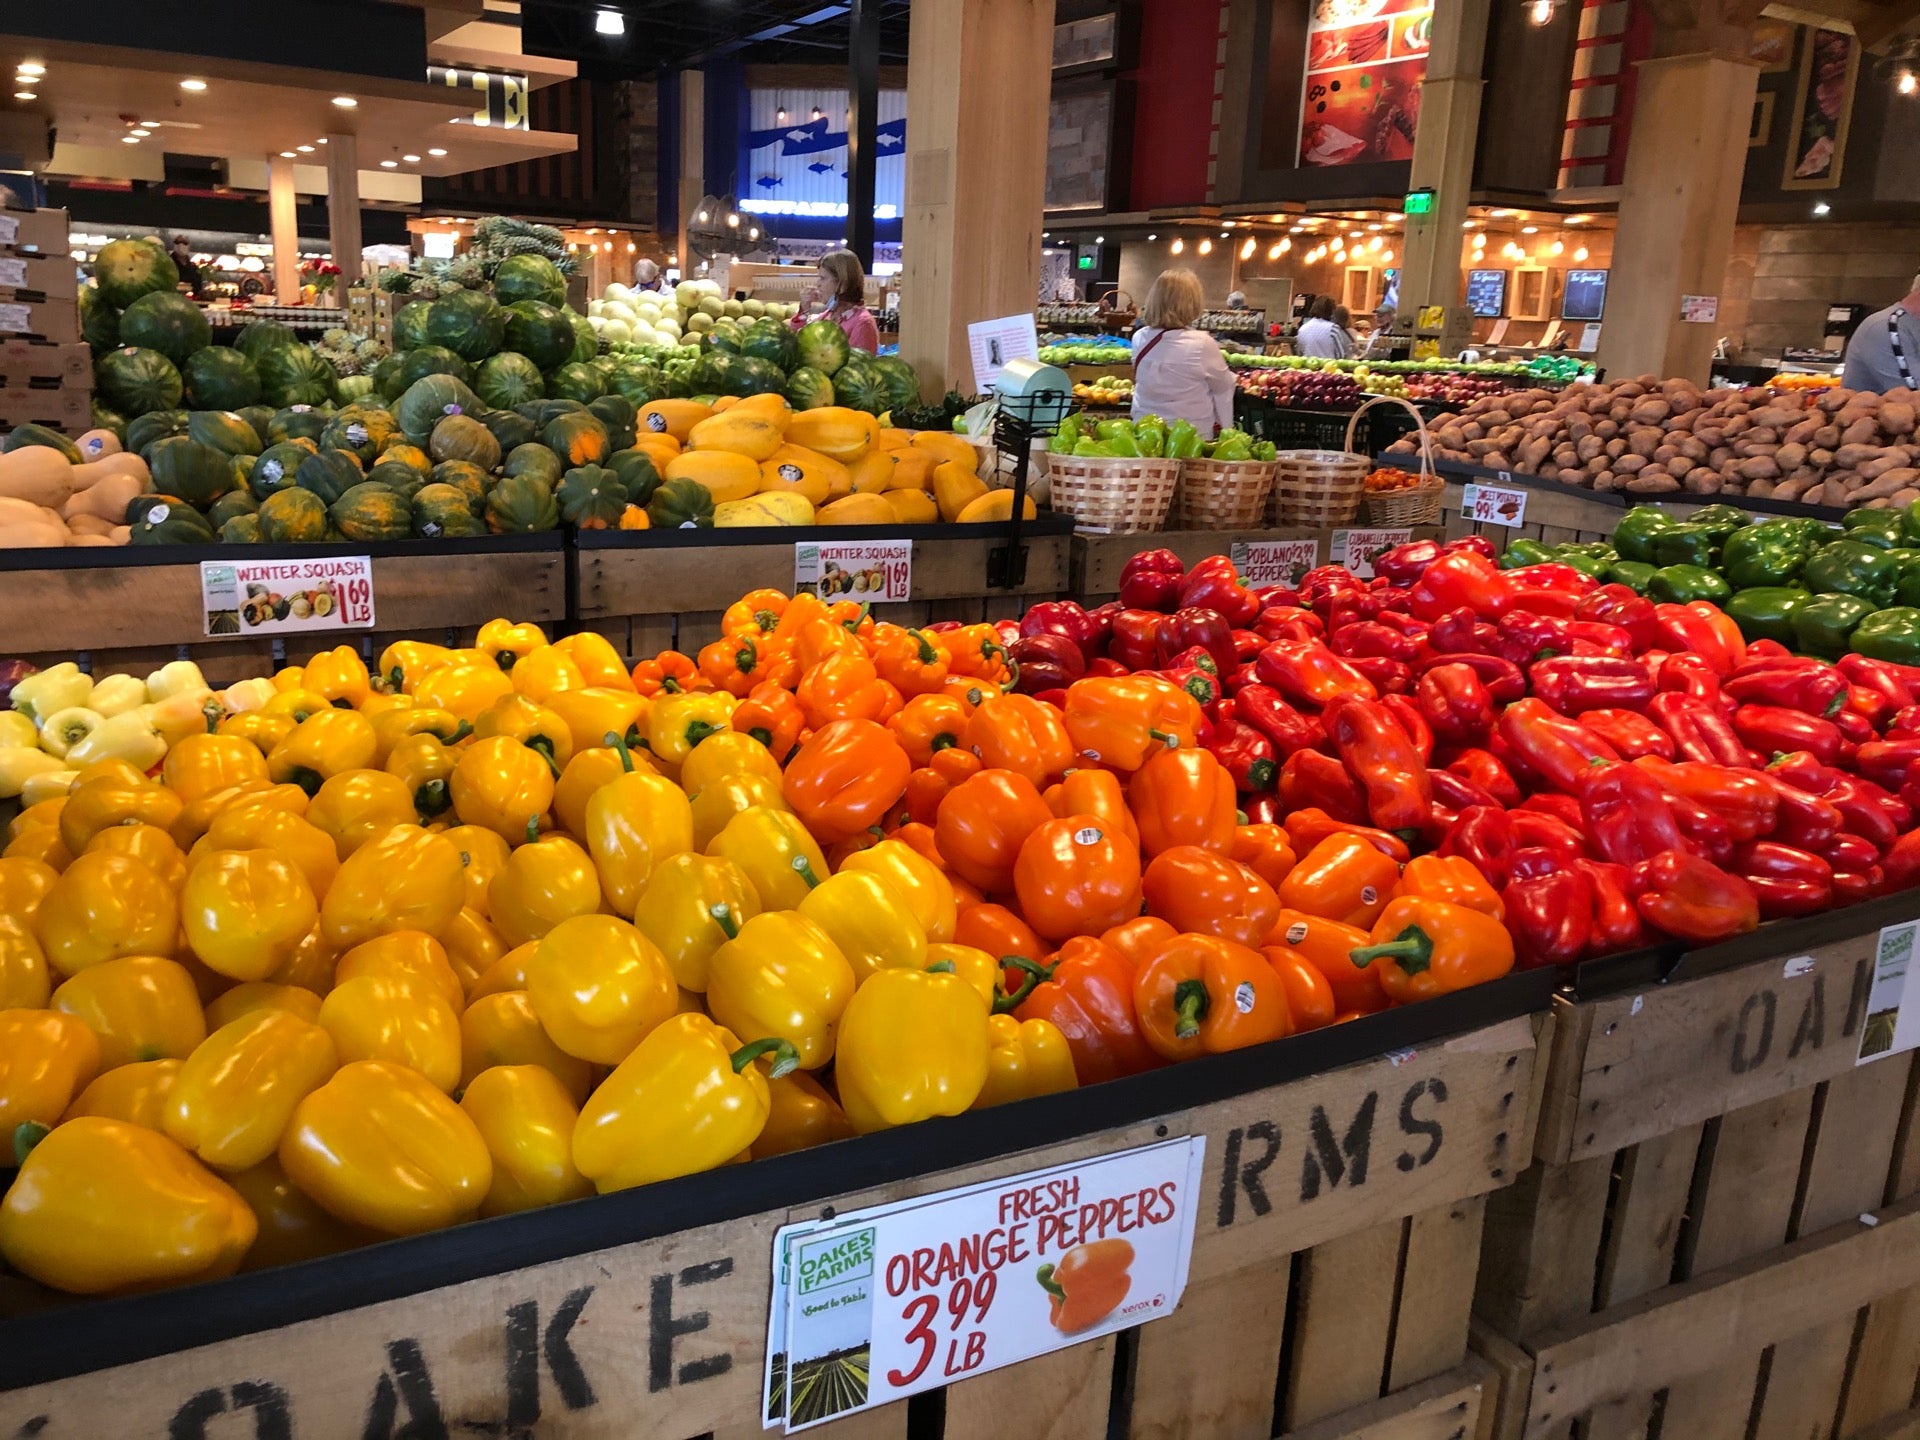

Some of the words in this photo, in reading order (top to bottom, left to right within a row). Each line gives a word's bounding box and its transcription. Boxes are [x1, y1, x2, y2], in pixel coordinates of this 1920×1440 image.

[1476, 501, 1490, 519] 99
[820, 547, 863, 560] WINTER
[865, 546, 907, 560] SQUASH
[1246, 548, 1291, 565] POBLANO
[237, 564, 300, 581] WINTER
[303, 561, 365, 579] SQUASH
[1246, 564, 1291, 582] PEPPERS
[893, 584, 908, 598] LB
[352, 605, 371, 623] LB
[998, 1175, 1080, 1225] FRESH
[885, 1223, 1029, 1297] ORANGE
[1037, 1181, 1177, 1256] PEPPERS
[799, 1231, 872, 1276] OAKES
[803, 1246, 874, 1291] FARMS
[801, 1299, 829, 1317] Seed
[830, 1297, 840, 1309] to
[840, 1287, 867, 1305] Table
[1121, 1299, 1151, 1314] xerox
[944, 1331, 987, 1378] LB
